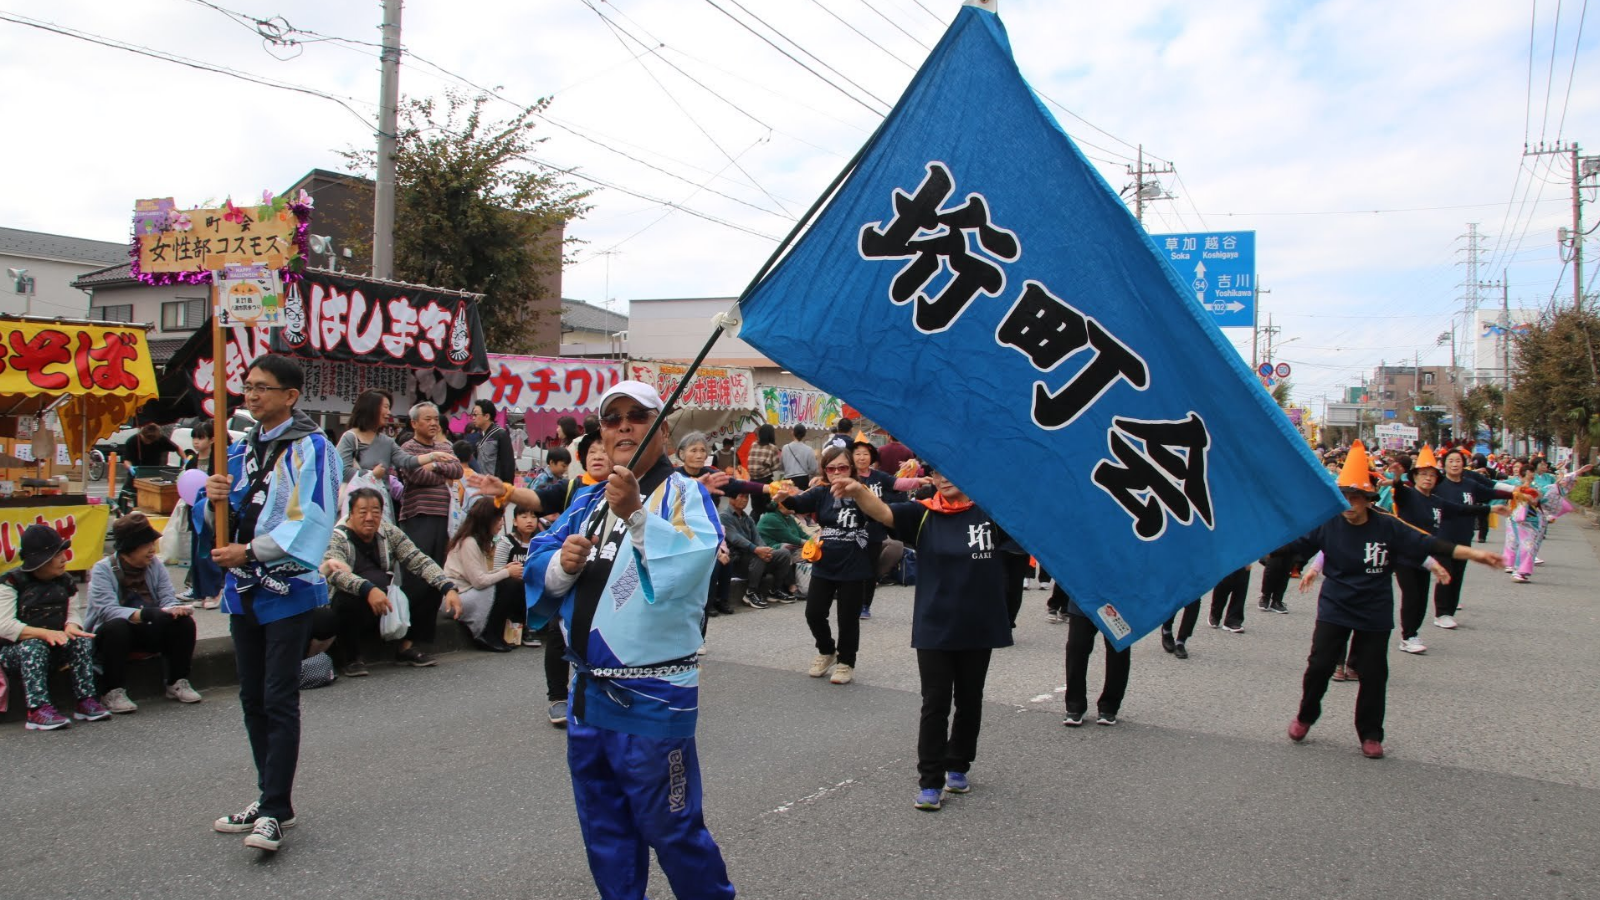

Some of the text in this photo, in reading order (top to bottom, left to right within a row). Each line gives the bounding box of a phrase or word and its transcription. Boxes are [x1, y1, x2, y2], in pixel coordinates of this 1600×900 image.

[1165, 236, 1237, 251] 草加 越谷
[1171, 251, 1239, 260] Soka Koshigaya
[1195, 281, 1205, 289] 54
[1218, 274, 1250, 288] 吉川
[1213, 303, 1225, 311] 102
[309, 282, 452, 362] はしまき
[0, 330, 139, 391] そば
[668, 749, 686, 813] Kappa
